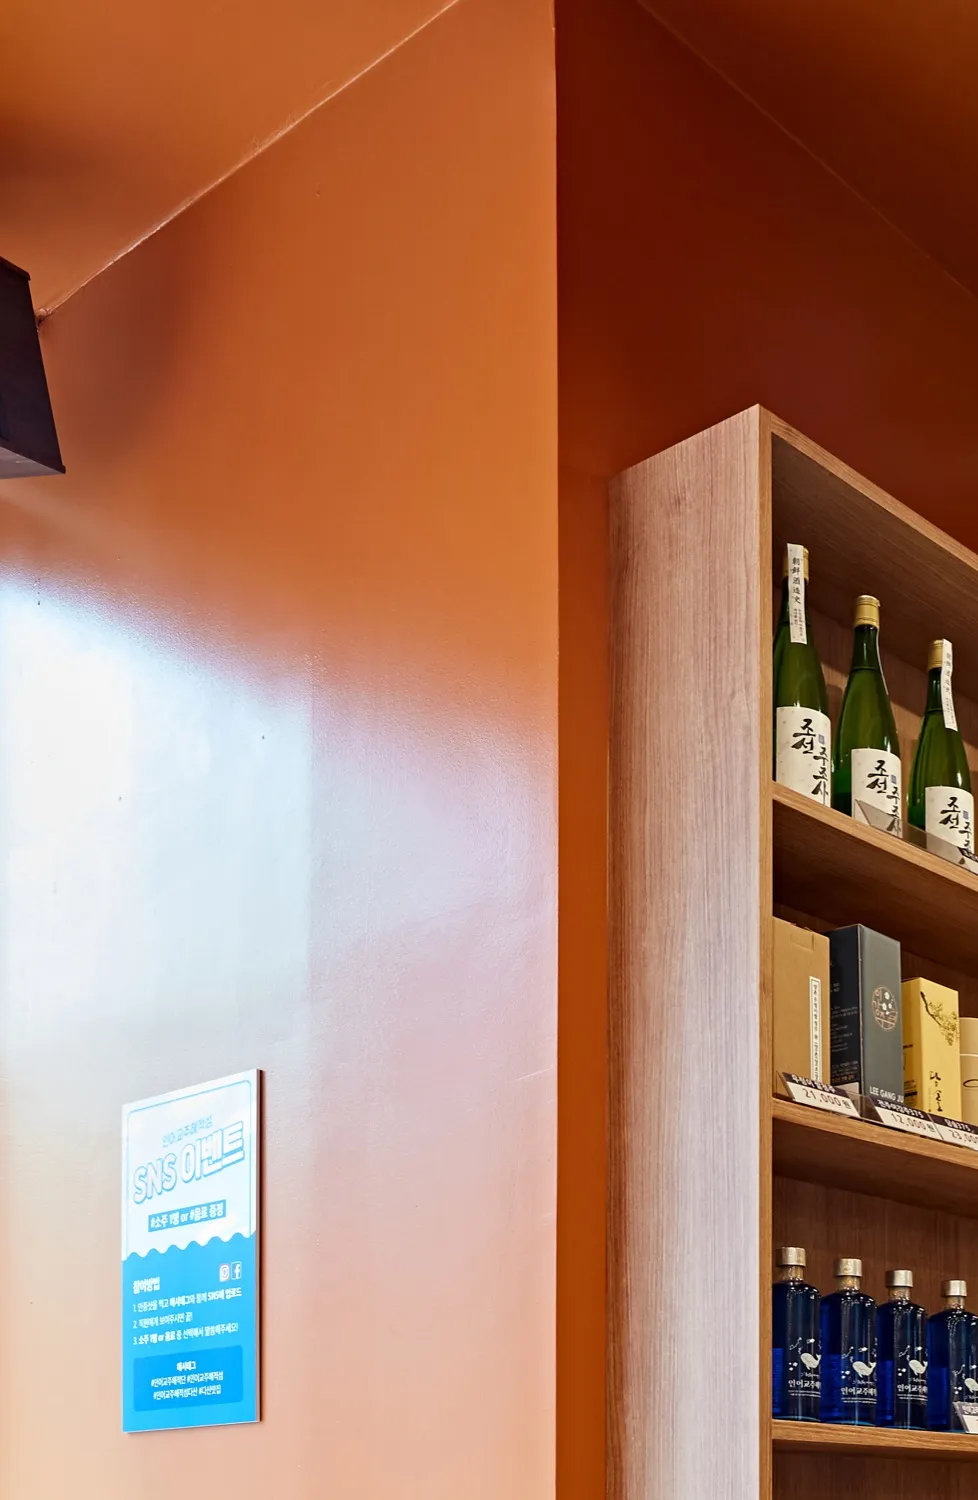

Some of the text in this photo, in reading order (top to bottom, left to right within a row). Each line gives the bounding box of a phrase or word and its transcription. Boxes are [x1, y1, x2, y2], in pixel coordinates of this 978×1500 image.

[869, 1086, 879, 1095] LEE
[880, 1089, 896, 1101] GANG
[133, 1120, 245, 1204] SNS 이벤트
[181, 1213, 189, 1223] or
